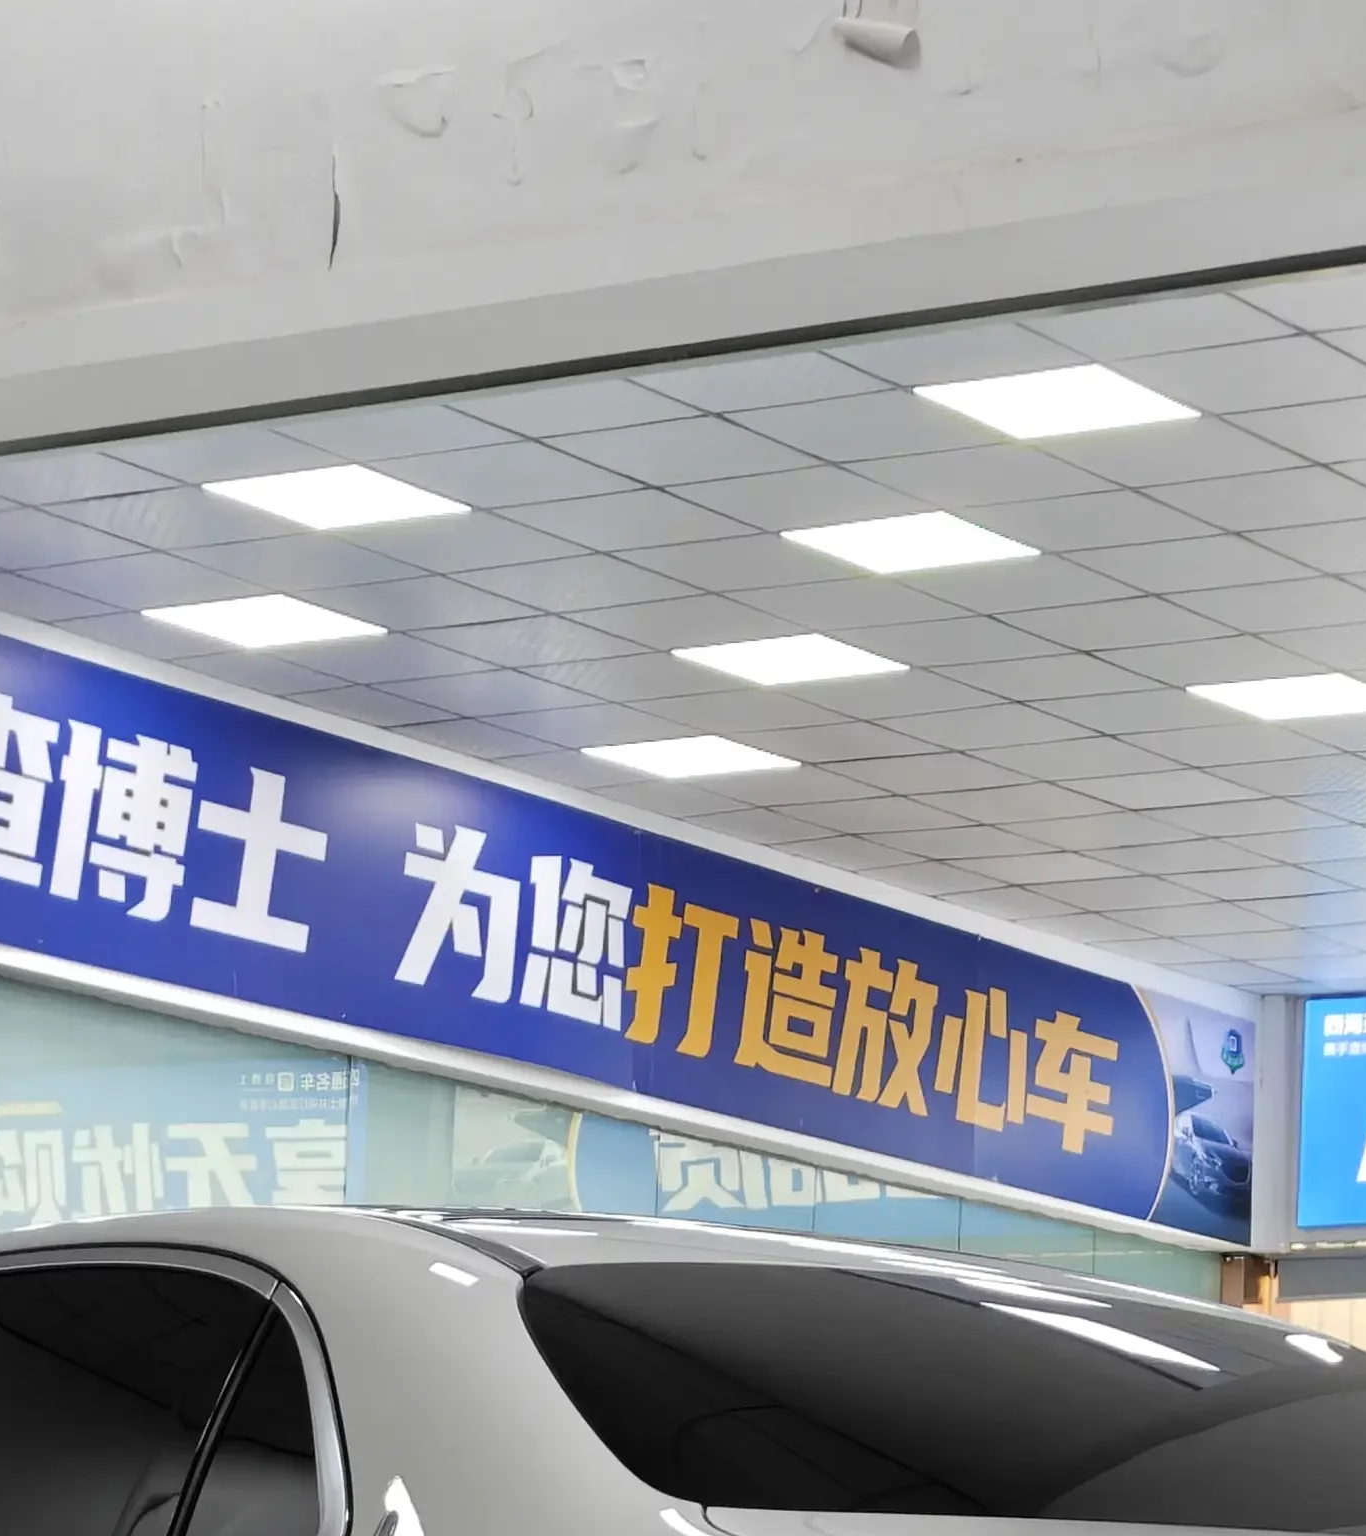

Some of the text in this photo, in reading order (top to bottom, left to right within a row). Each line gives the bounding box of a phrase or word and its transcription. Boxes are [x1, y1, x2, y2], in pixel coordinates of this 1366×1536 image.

[394, 822, 1119, 1155] 为您打造放心车
